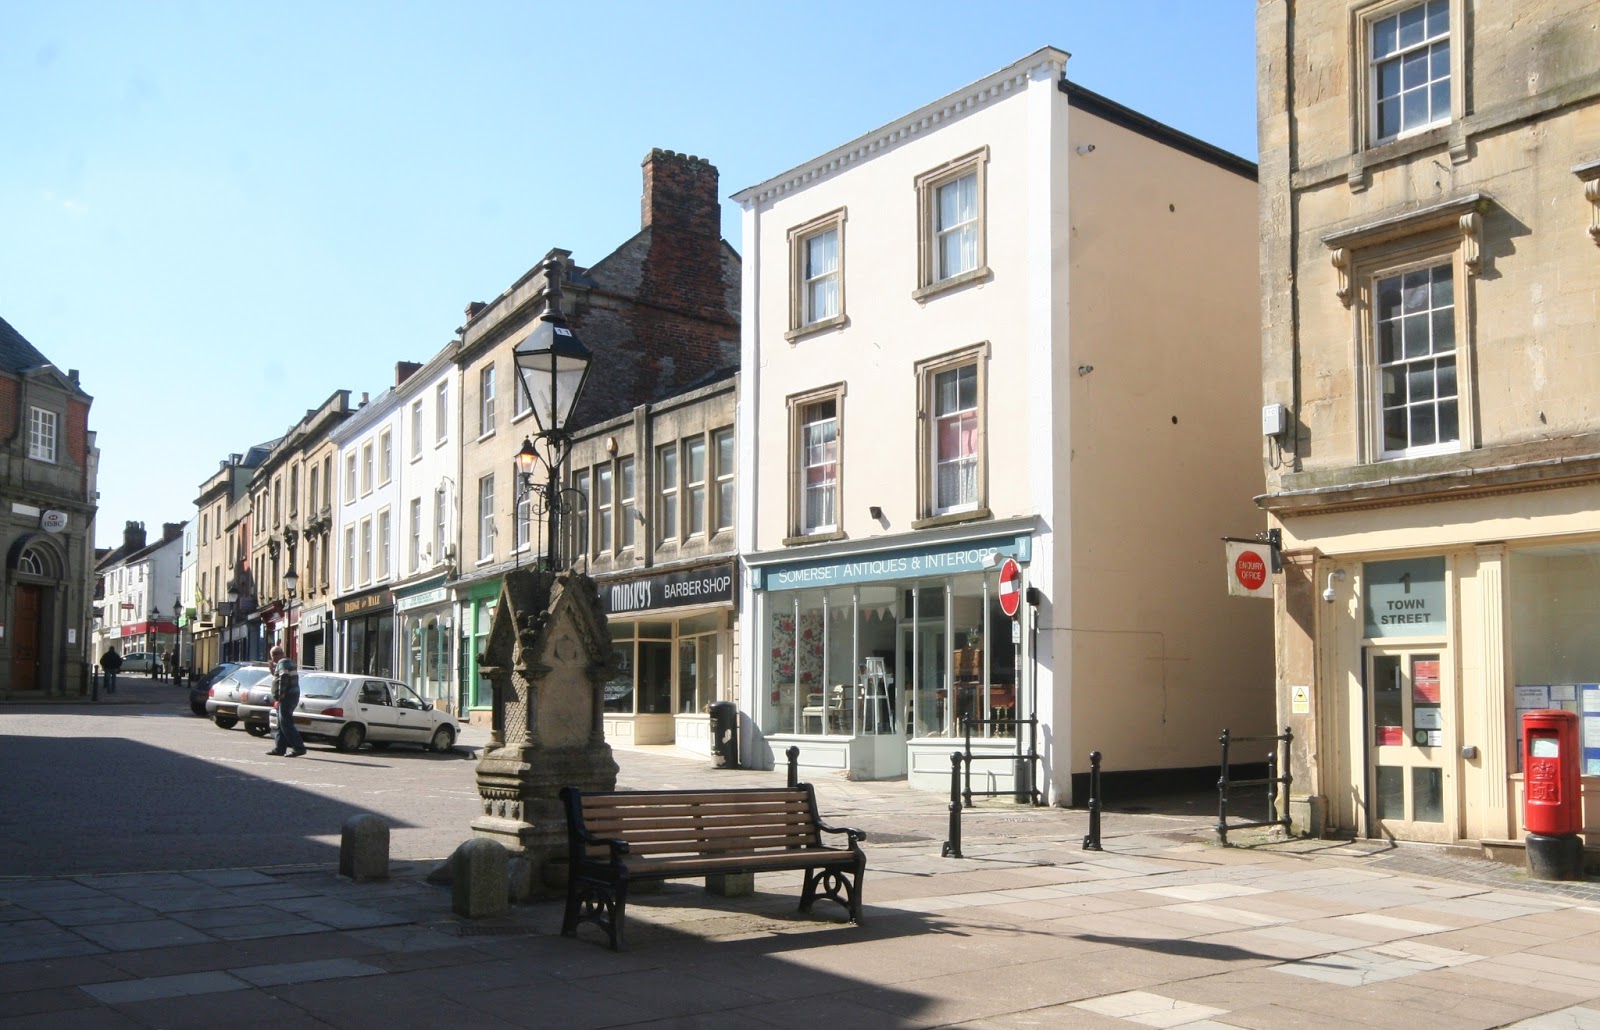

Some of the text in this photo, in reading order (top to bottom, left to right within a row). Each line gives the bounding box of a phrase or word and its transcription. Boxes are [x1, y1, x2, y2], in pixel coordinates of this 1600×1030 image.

[44, 520, 63, 528] HSBC
[779, 565, 839, 583] SOMERSET
[843, 558, 907, 577] ANTIQUES
[911, 556, 920, 570] &
[1238, 560, 1263, 571] ENQUIRY
[1241, 570, 1262, 580] OFFICE
[664, 580, 702, 599] BARBER
[702, 576, 731, 594] SHOP
[1399, 572, 1411, 594] 1
[1386, 599, 1425, 611] TOWN
[1381, 612, 1431, 625] STREET
